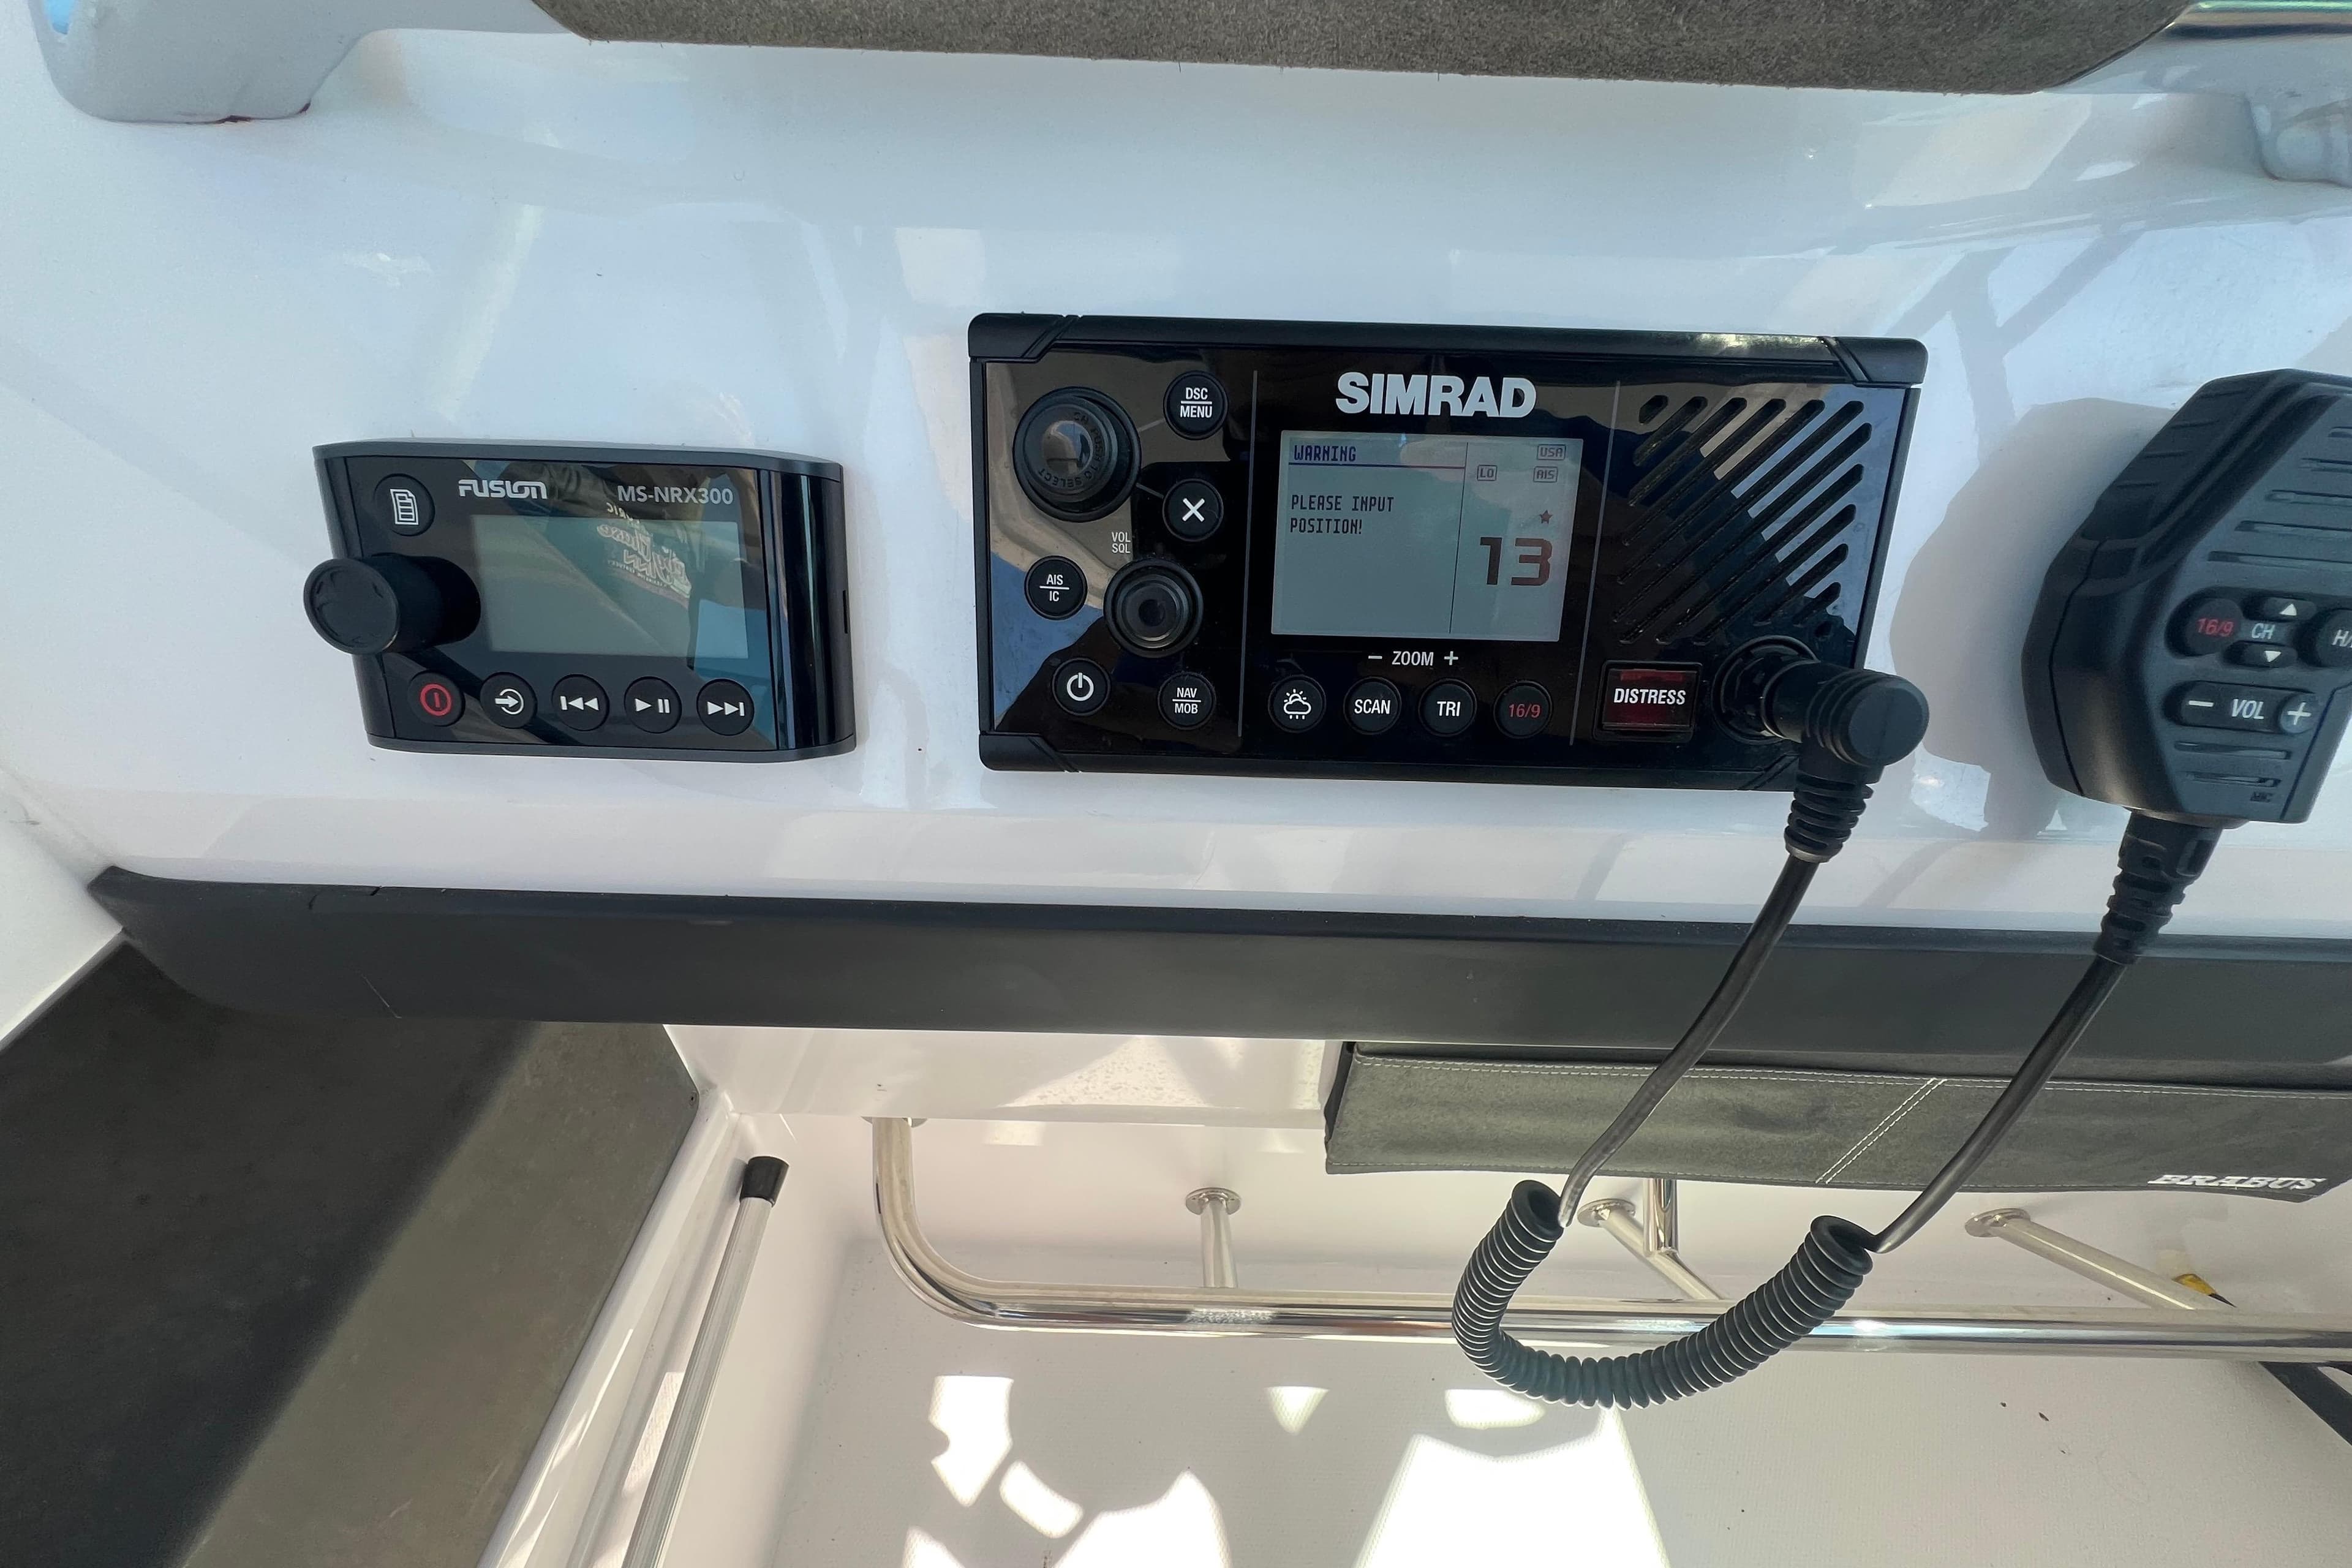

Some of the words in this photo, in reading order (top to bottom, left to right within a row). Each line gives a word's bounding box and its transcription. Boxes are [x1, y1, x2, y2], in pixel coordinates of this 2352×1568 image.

[1185, 387, 1208, 401] DSC
[1335, 371, 1537, 418] SIMRAD
[1180, 405, 1213, 418] MENU
[1294, 445, 1357, 462] WARNING
[1540, 448, 1563, 458] USA
[1038, 468, 1083, 488] SELECT
[1480, 468, 1494, 478] LO
[1536, 470, 1555, 480] AIS
[458, 479, 548, 500] FUSION
[617, 484, 734, 505] MS-NRX300
[1291, 494, 1343, 511] PLEASE
[1351, 496, 1394, 513] INPUT
[1289, 518, 1363, 535] POSITION!
[1111, 531, 1131, 543] VOL
[1112, 543, 1131, 554] SQL
[1479, 537, 1553, 586] 13
[1046, 574, 1064, 586] AIS
[1049, 590, 1060, 602] IC
[2197, 618, 2235, 638] 16/9
[2251, 623, 2275, 639] CH
[2332, 629, 2352, 648] H/
[1391, 650, 1434, 667] ZOOM
[1177, 687, 1197, 699] NAV
[1613, 688, 1687, 706] DISTRESS
[1174, 703, 1198, 714] MOB
[1354, 699, 1391, 715] SCAN
[1436, 700, 1461, 718] TRI
[1508, 703, 1540, 719] 16/9
[2231, 698, 2265, 720] VOL
[2147, 1174, 2327, 1190] BRABUS
